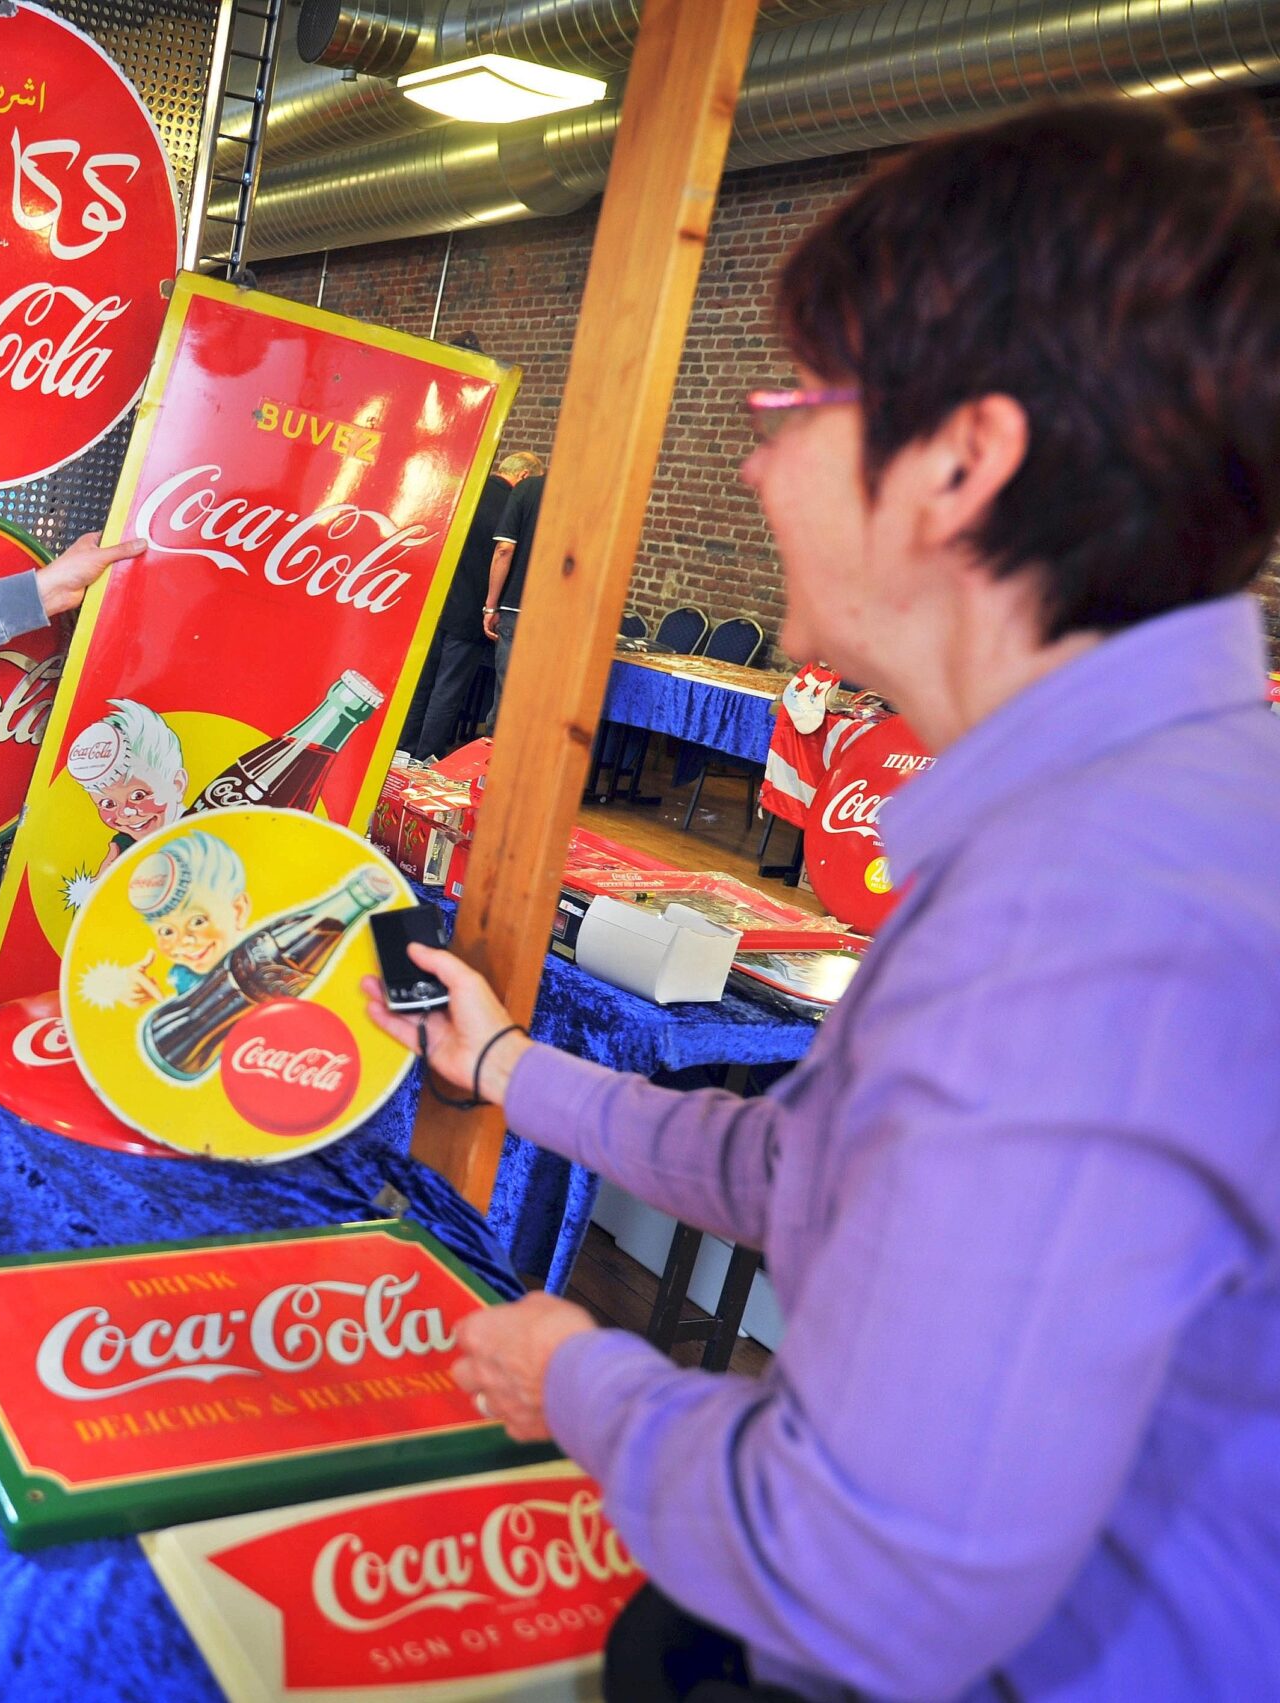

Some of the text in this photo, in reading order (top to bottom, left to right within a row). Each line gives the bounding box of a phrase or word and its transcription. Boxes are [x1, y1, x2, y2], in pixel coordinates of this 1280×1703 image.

[257, 402, 382, 462] BUVEZ
[135, 464, 440, 614] Coca-Cola
[69, 741, 113, 761] Coca-Cola
[231, 1036, 351, 1092] Coca-Cola
[126, 1269, 238, 1299] DRINK
[36, 1270, 457, 1400] Coca-Cola
[72, 1369, 454, 1446] DELICIOUS & REFRESH
[370, 1635, 452, 1673] SIGN
[460, 1623, 502, 1653] OF
[511, 1603, 606, 1641] GOOD
